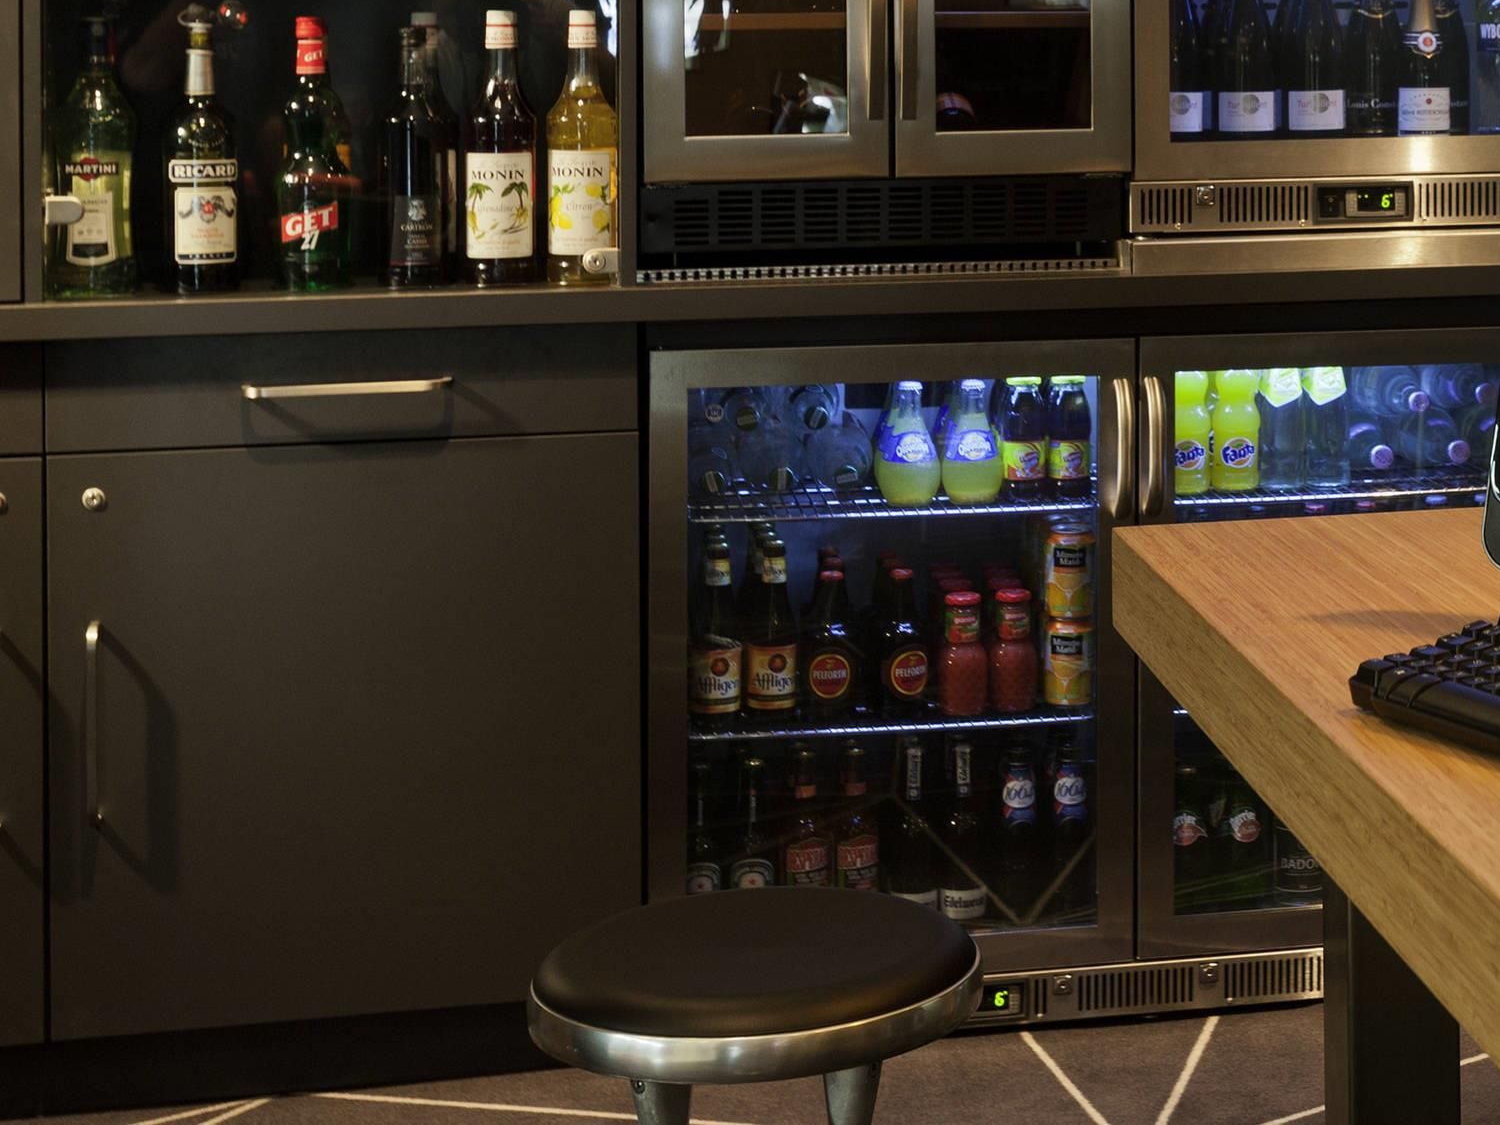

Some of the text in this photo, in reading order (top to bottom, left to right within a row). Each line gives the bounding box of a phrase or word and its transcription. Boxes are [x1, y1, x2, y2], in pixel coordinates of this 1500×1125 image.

[65, 163, 116, 174] MARTINI
[173, 164, 236, 179] RICARD
[552, 166, 604, 178] MONIN
[471, 170, 525, 181] MONIN
[285, 207, 333, 237] GET
[301, 230, 320, 251] 27
[1221, 443, 1256, 464] Fanta
[1280, 858, 1321, 870] BADO
